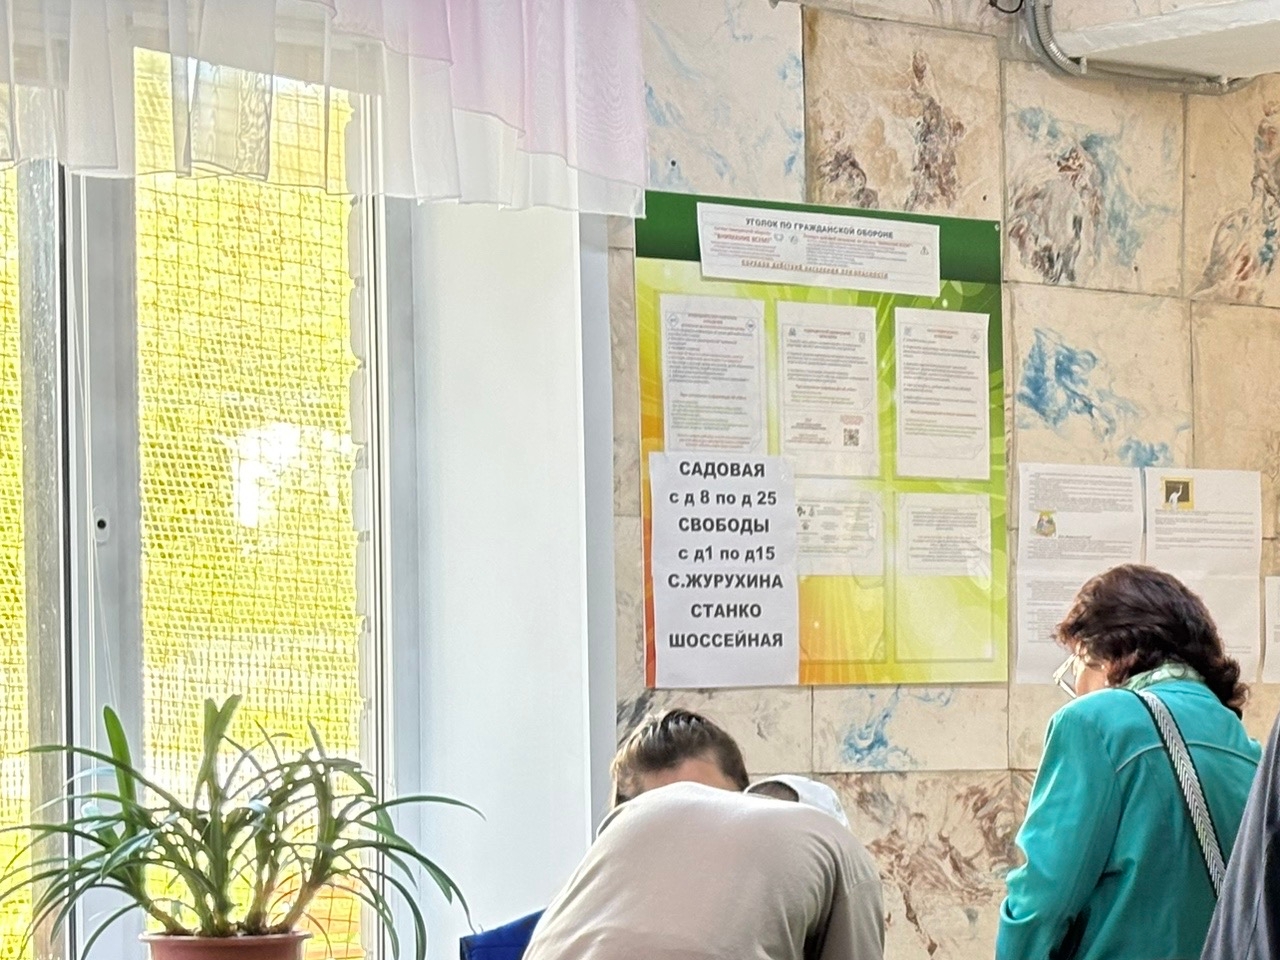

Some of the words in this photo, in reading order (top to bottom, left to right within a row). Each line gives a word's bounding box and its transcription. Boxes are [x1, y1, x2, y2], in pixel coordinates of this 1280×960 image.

[745, 217, 778, 228] УГОЛОК
[780, 221, 792, 229] ПО
[794, 222, 855, 235] ГРАЖДАНСКОЙ
[857, 228, 893, 239] ОБОРОНЕ
[679, 461, 765, 479] САДОВАЯ
[669, 492, 679, 503] с
[684, 493, 695, 507] д
[700, 490, 710, 504] 8
[716, 493, 736, 505] по
[742, 494, 752, 508] д
[757, 491, 777, 505] 25
[678, 517, 769, 535] СВОБОДЫ
[678, 549, 688, 560] с
[694, 545, 713, 563] д1
[720, 549, 740, 560] по
[745, 545, 775, 563] д15
[668, 573, 783, 588] С.ЖУРУХИНА
[691, 603, 762, 618] СТАНКО
[669, 630, 783, 648] ШОССЕЙНАЯ
